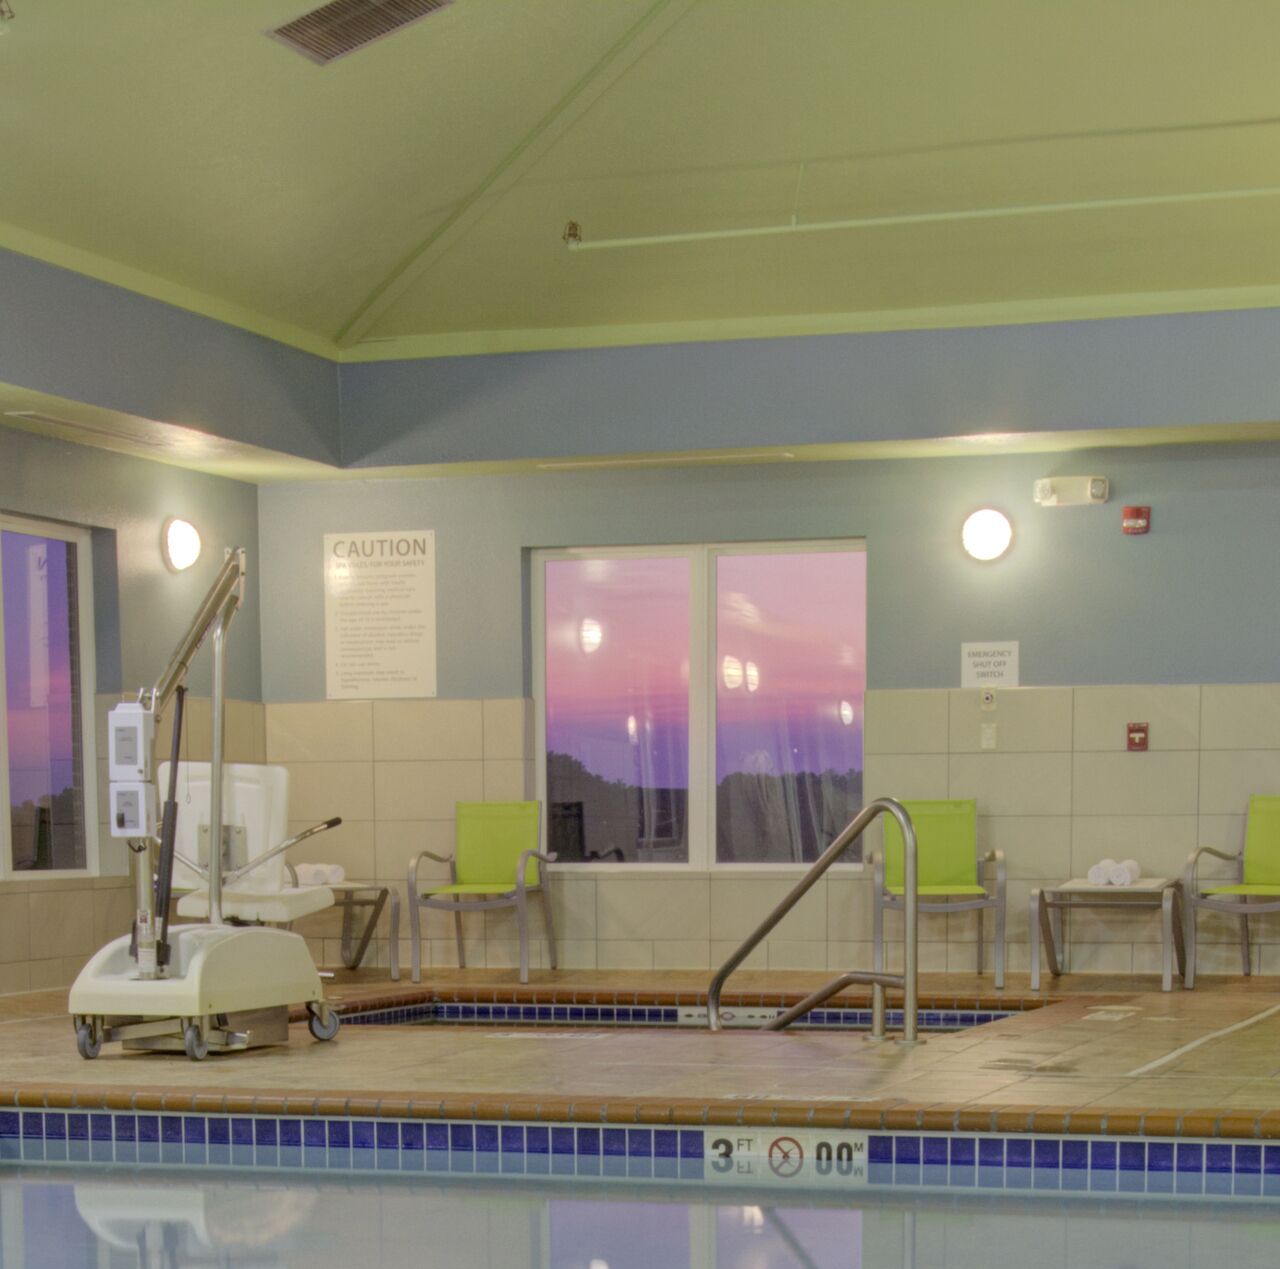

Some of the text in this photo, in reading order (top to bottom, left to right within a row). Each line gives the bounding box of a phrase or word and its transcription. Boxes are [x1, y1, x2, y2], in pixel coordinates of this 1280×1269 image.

[332, 538, 427, 559] CAUTION
[967, 649, 1012, 659] EMERGENCY
[972, 660, 1007, 669] SHUT OFF
[976, 670, 1004, 679] SWITCH
[737, 1138, 753, 1152] FT
[853, 1142, 864, 1152] M
